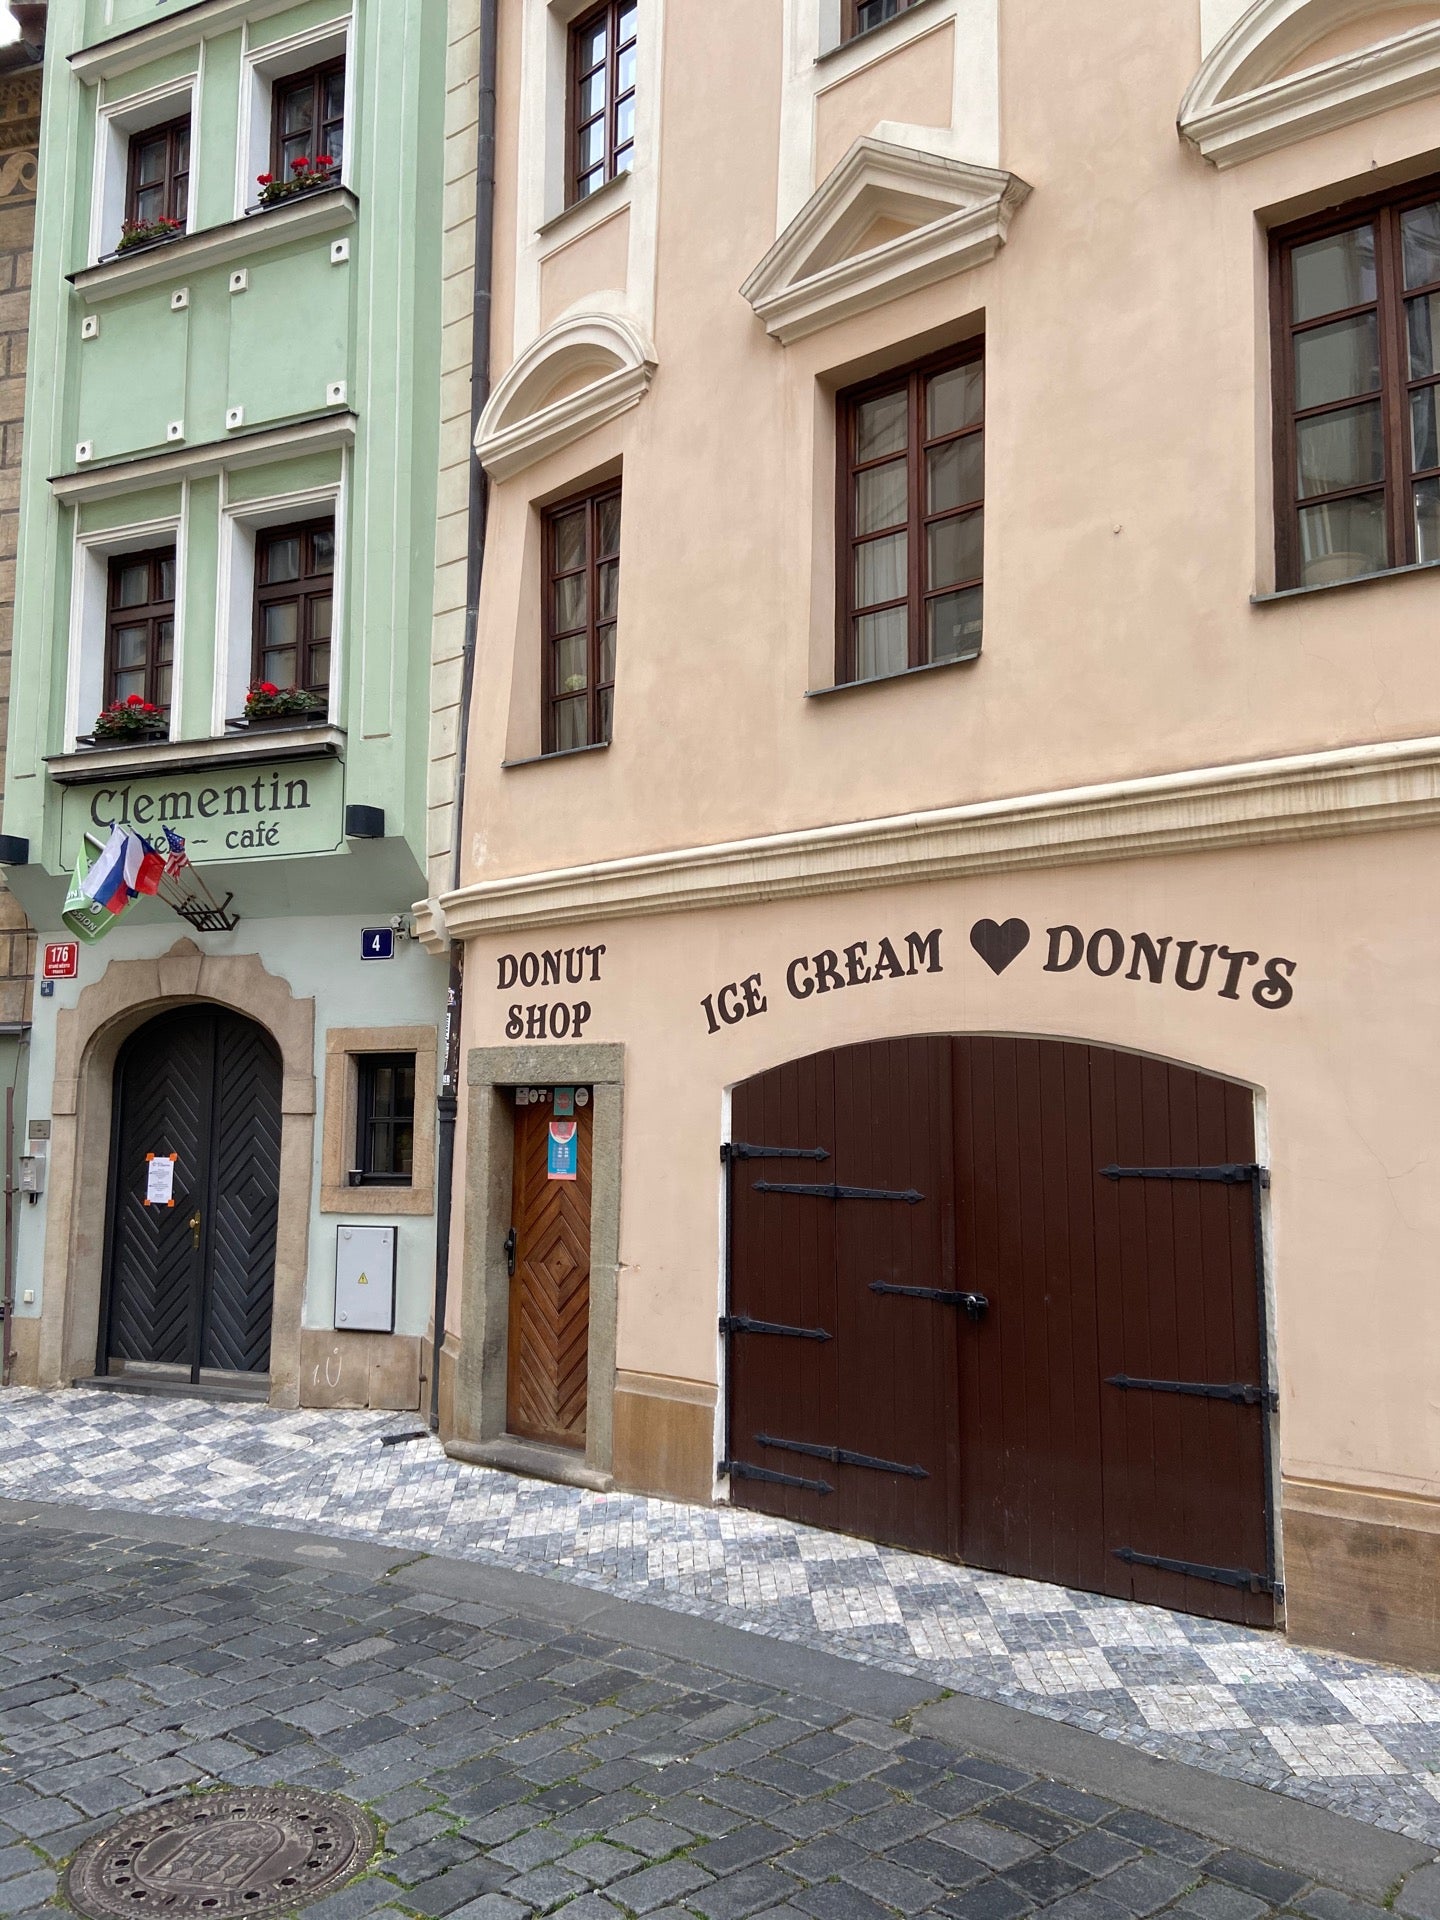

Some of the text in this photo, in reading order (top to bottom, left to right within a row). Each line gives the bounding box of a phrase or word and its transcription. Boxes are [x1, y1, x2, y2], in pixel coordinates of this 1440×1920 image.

[90, 772, 311, 827] Clementin
[226, 821, 280, 850] café
[51, 946, 69, 962] 176
[371, 934, 381, 952] 4
[496, 944, 607, 990] DONUT
[700, 925, 1297, 1035] ICE CREAM DONUTS
[505, 1001, 592, 1040] SHOP
